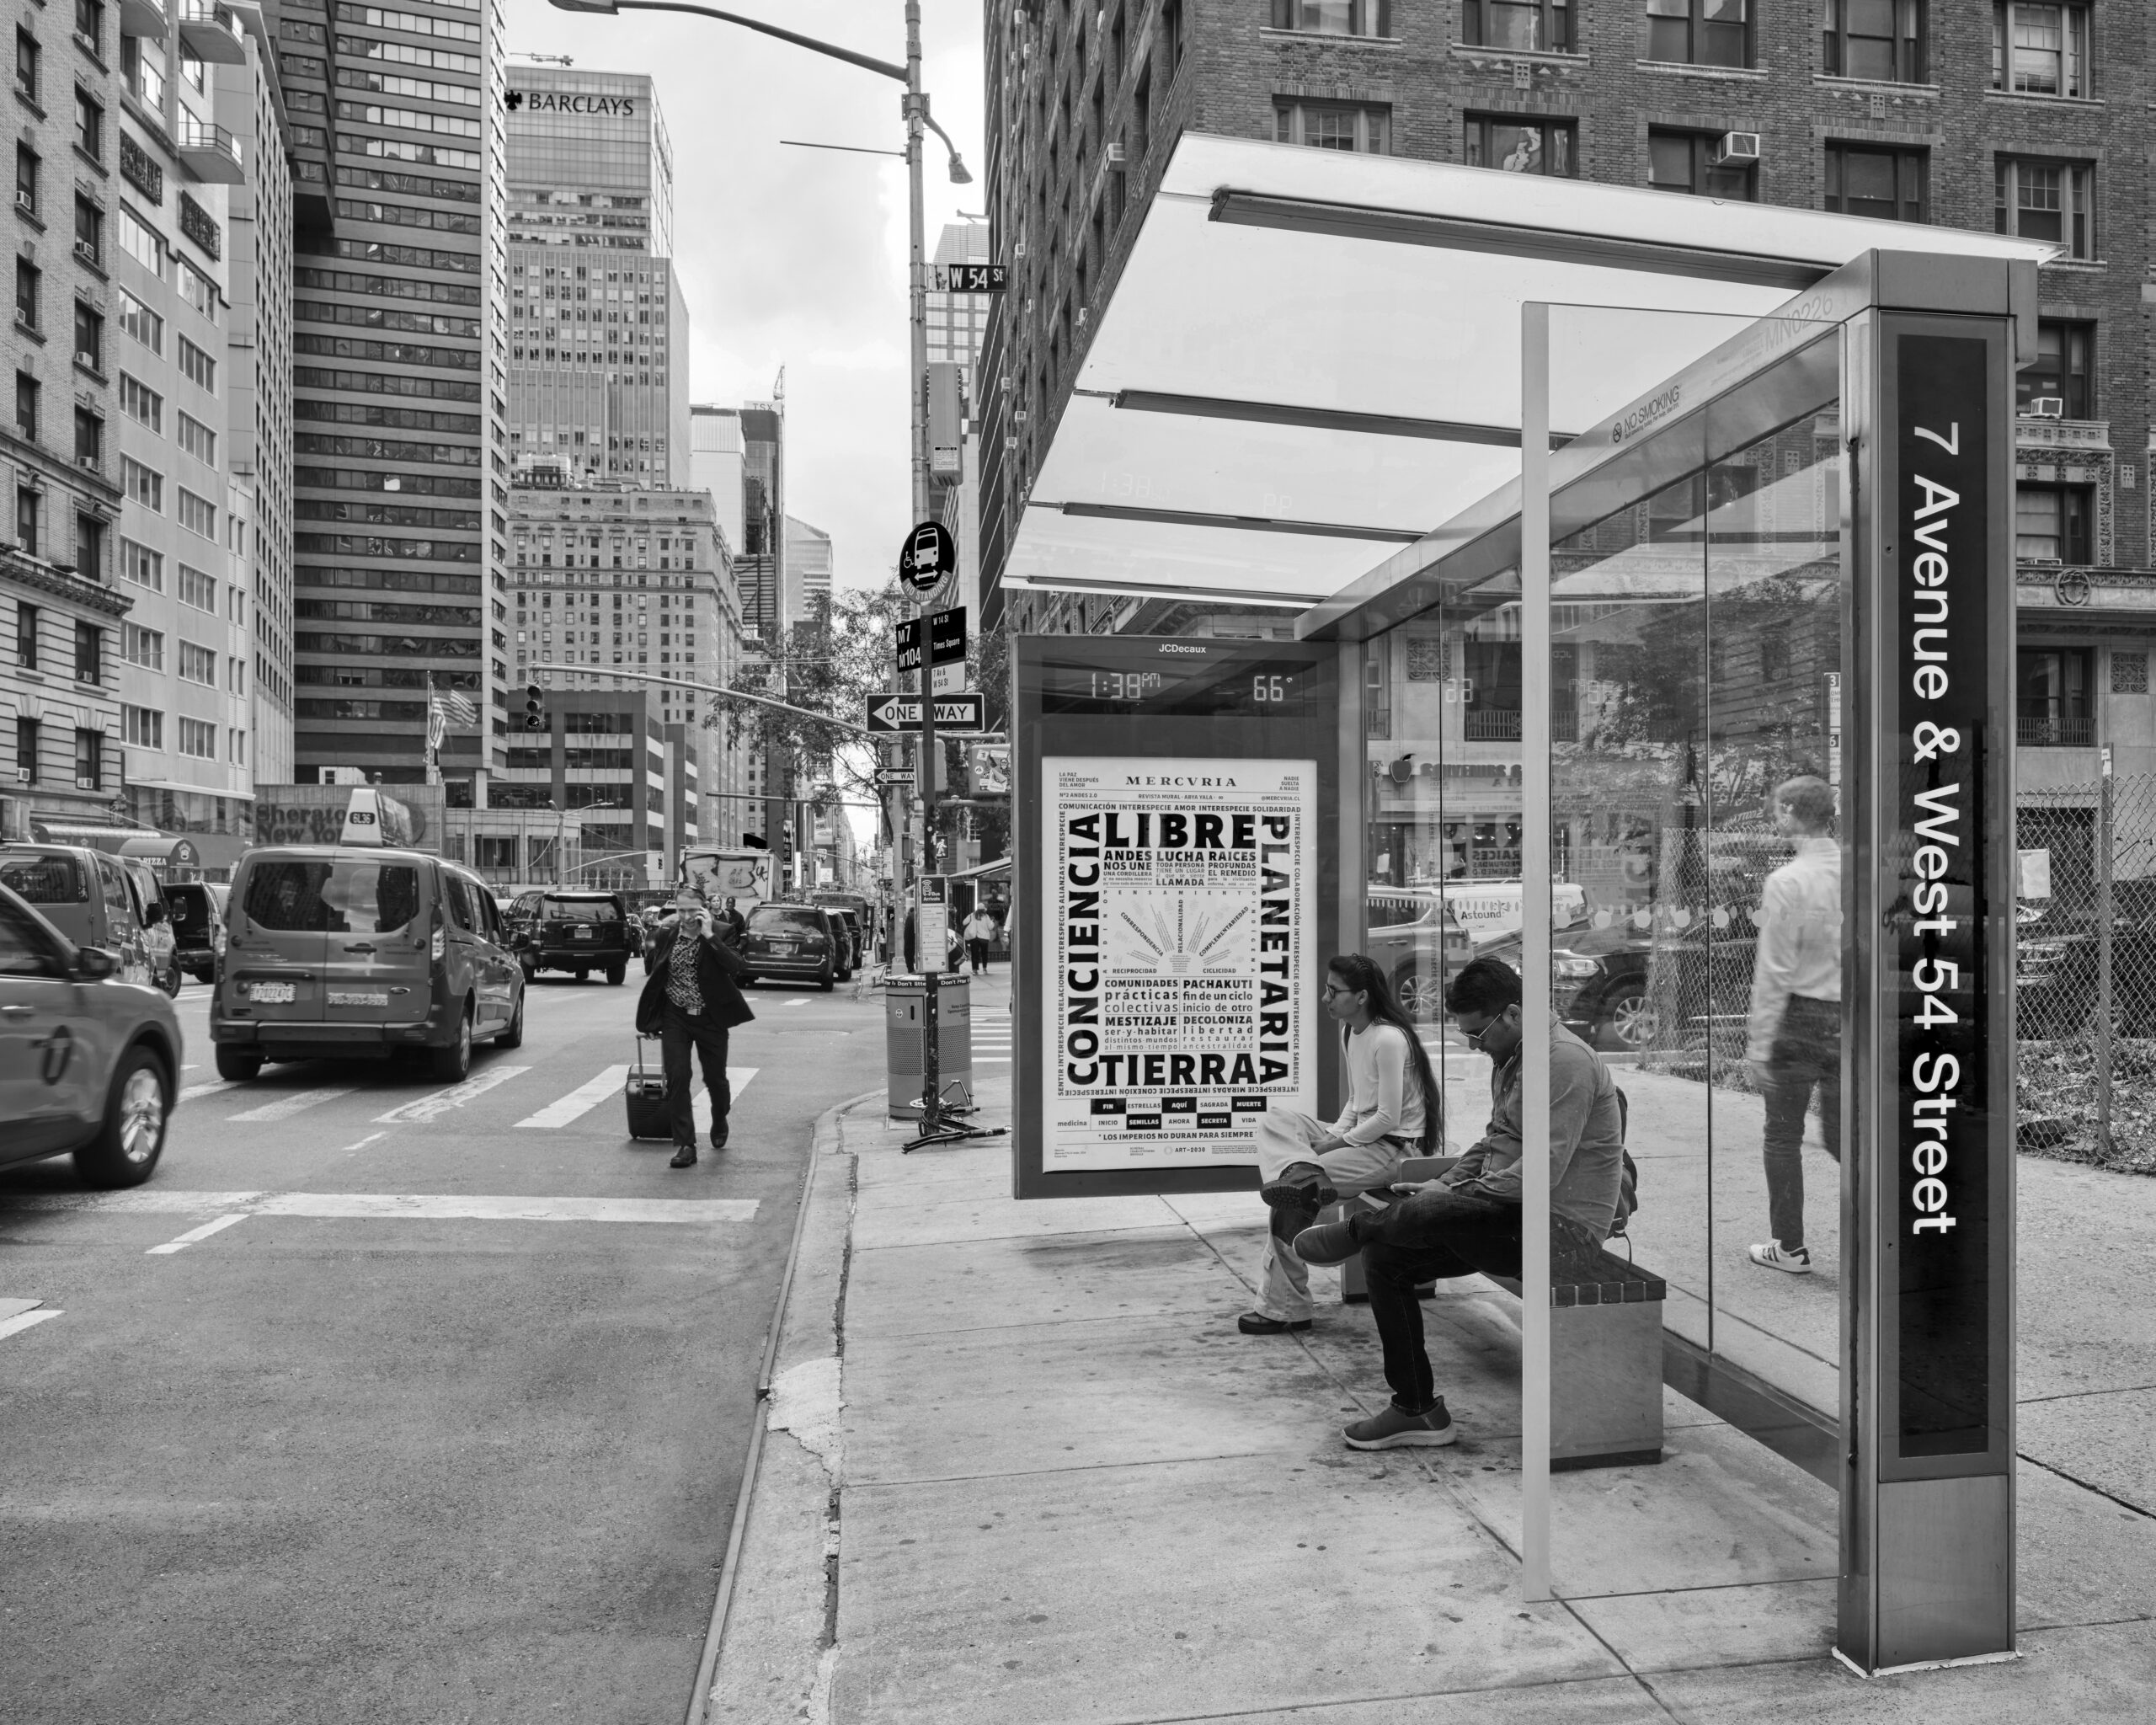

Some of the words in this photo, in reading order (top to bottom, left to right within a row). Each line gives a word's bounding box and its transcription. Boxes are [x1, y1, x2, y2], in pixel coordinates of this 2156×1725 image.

[529, 93, 633, 115] BARCLAYS
[950, 267, 963, 288] W
[969, 267, 988, 289] 54
[993, 268, 1003, 282] St
[1765, 294, 1833, 352] MN0226
[752, 403, 773, 411] TSX
[1624, 413, 1637, 433] NO
[1638, 385, 1679, 424] SMOKING
[1913, 423, 1959, 455] 7
[905, 582, 915, 596] NO
[916, 576, 948, 600] STANDING
[1913, 474, 1959, 700] Avenue
[898, 625, 911, 644] M7
[933, 641, 945, 651] Times
[946, 638, 960, 649] Square
[1158, 644, 1206, 654] JCDecaux
[899, 646, 921, 668] M104
[933, 680, 937, 688] W
[1092, 672, 1141, 699] 1:38
[1142, 672, 1161, 688] PM
[885, 706, 917, 720] ONE
[934, 705, 968, 720] WAY
[1913, 721, 1960, 764] &
[1125, 776, 1236, 787] MERCVRIA
[256, 804, 347, 823] Sherato
[353, 813, 371, 823] 6L36
[257, 825, 304, 842] New
[1104, 813, 1256, 849] LIBRE
[1104, 850, 1152, 861] ANDES
[1157, 851, 1204, 862] LUCHA
[1209, 851, 1256, 861] RAICES
[1913, 782, 1959, 937] West
[1104, 862, 1126, 870] NOS
[1129, 862, 1152, 870] UNE
[1461, 911, 1501, 920] Astound
[1120, 912, 1164, 957] CORRESPONDENCIA
[1199, 906, 1249, 957] COMPLEMENTARIEDAD
[1067, 812, 1099, 1085] CONCIENCIA
[1260, 814, 1290, 1084] PLANETARIA
[1183, 980, 1252, 989] PACHAKUTI
[1105, 988, 1178, 1002] prácticas
[1183, 991, 1196, 1000] fin
[1199, 991, 1211, 1000] de
[1229, 991, 1253, 1000] ciclo
[1913, 958, 1957, 1030] 54
[1105, 1001, 1178, 1012] colectivas
[1183, 1003, 1211, 1012] inicio
[1215, 1003, 1227, 1012] de
[1105, 1016, 1177, 1026] MESTIZAJE
[1183, 1016, 1253, 1024] DECOLONIZA
[1183, 1025, 1253, 1034] libertad
[1099, 1054, 1258, 1086] TIERRA
[1171, 1101, 1187, 1109] AQUÍ
[1913, 1052, 1959, 1235] Street
